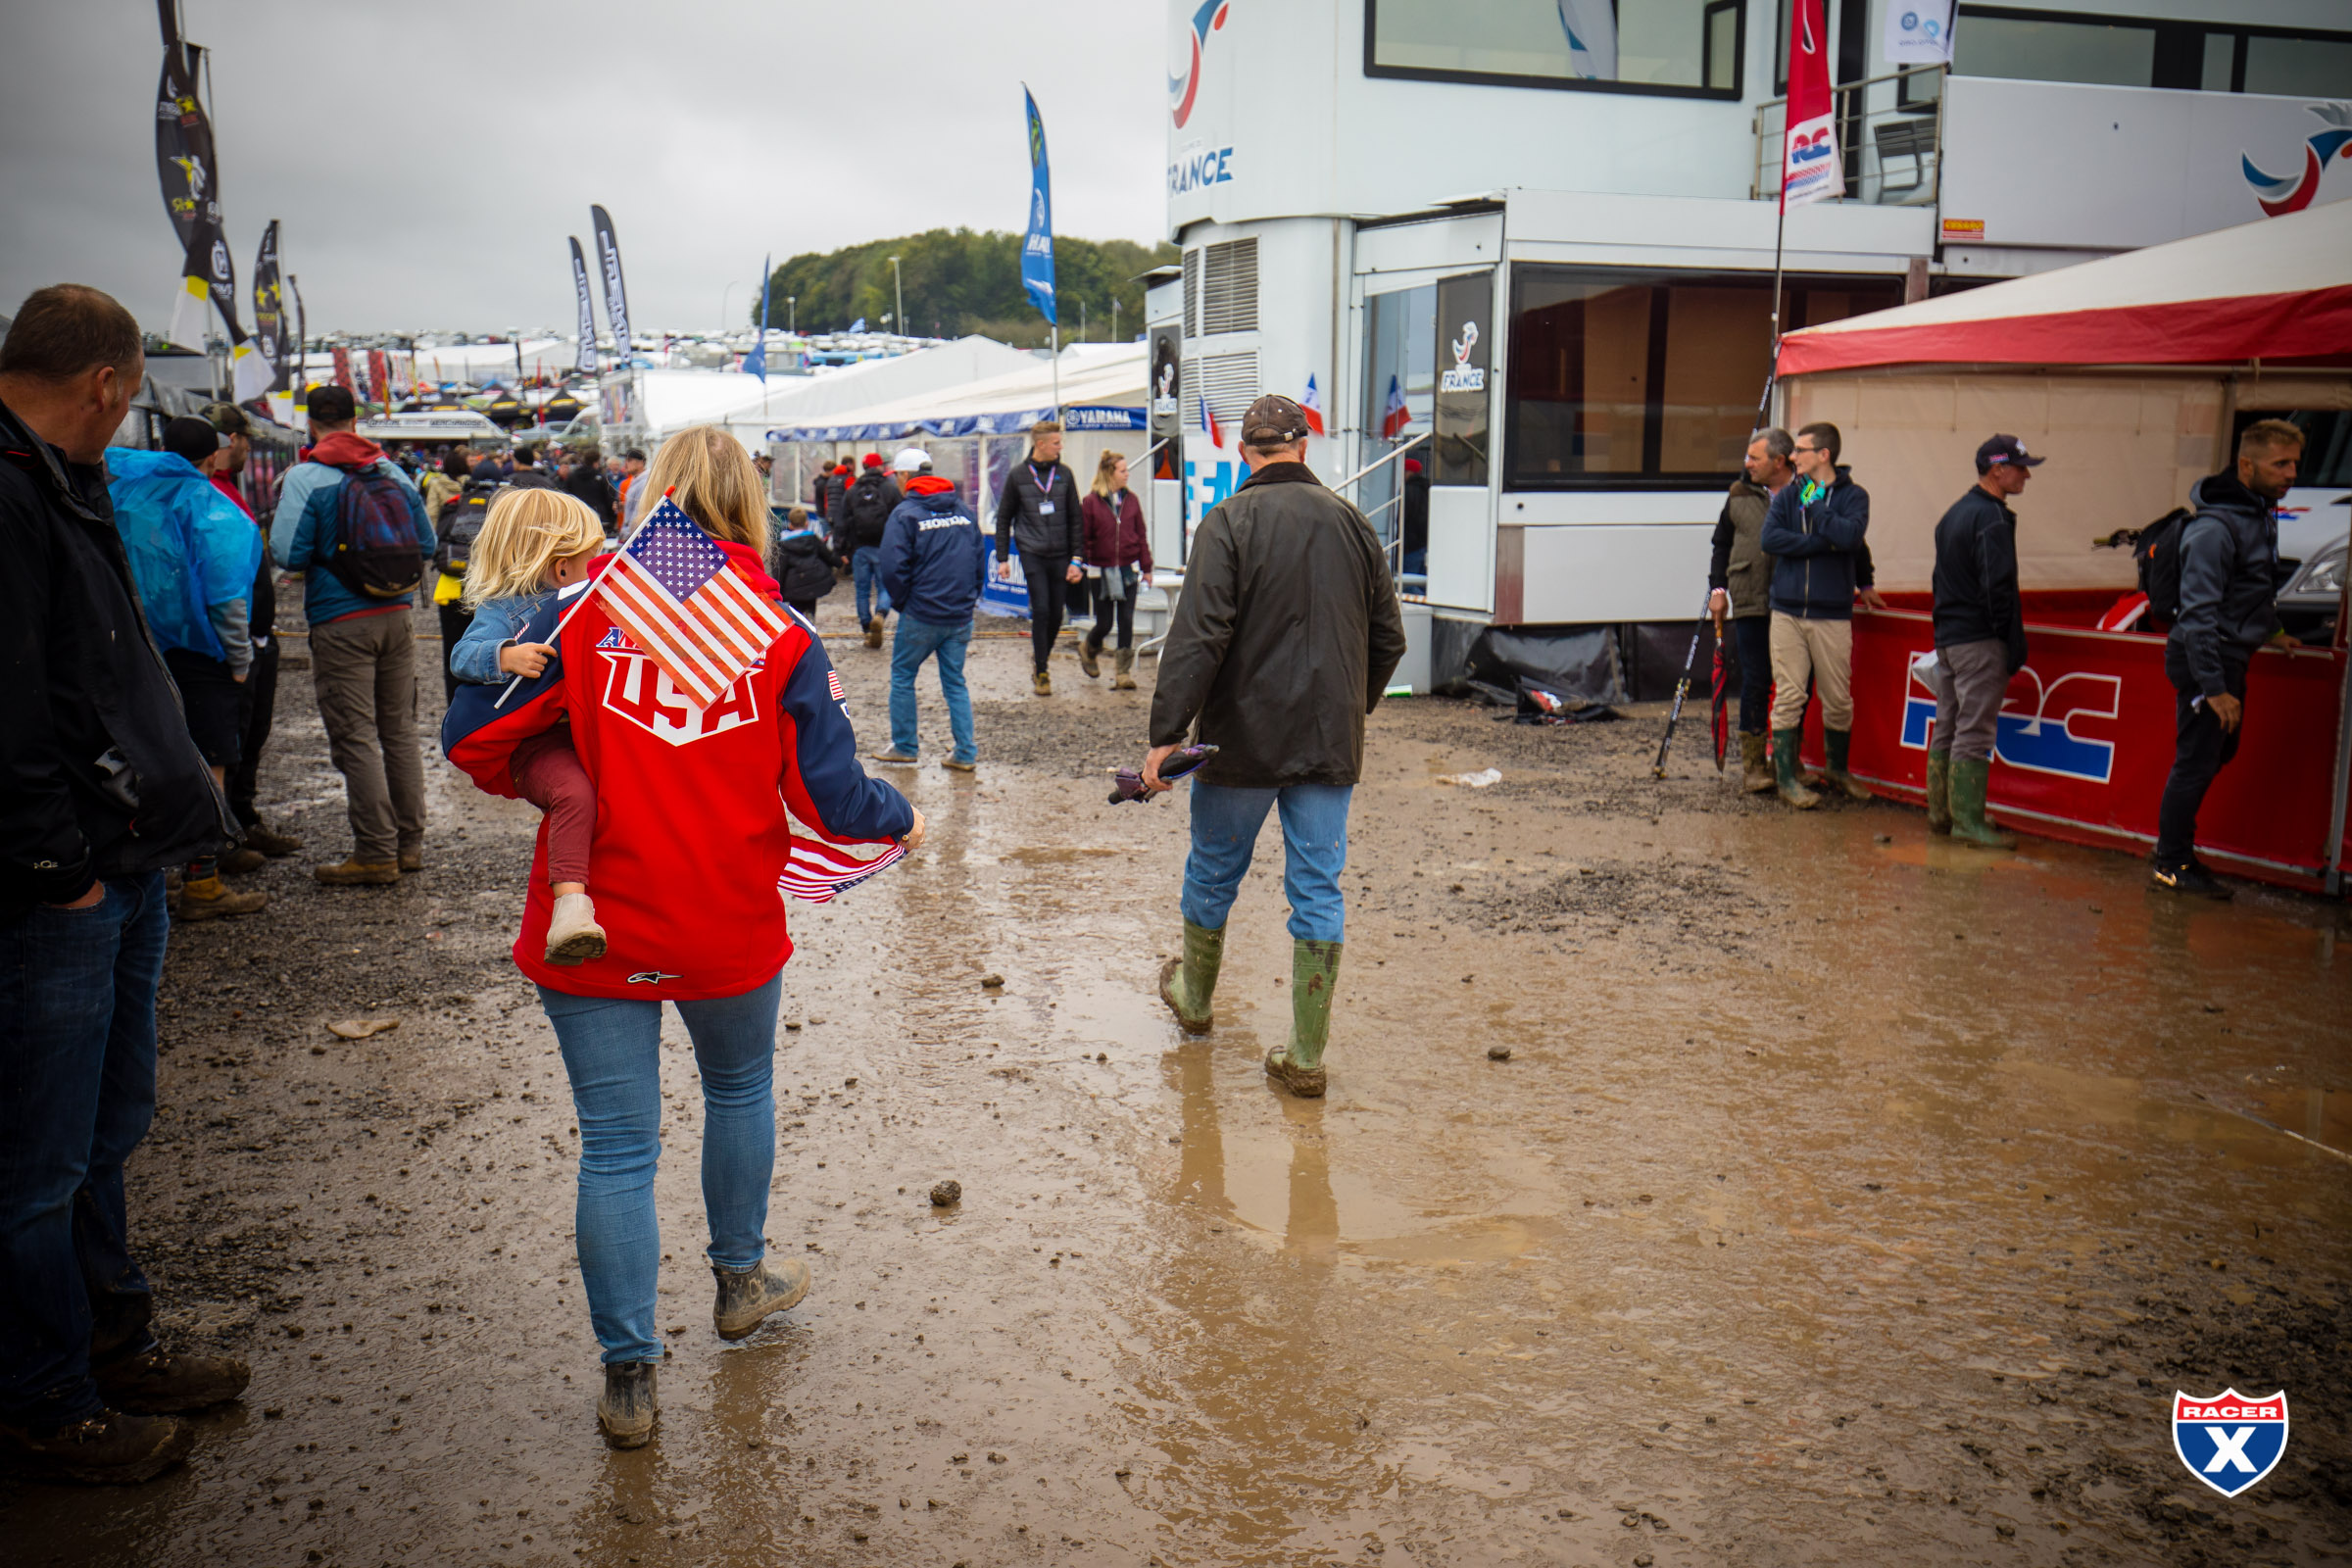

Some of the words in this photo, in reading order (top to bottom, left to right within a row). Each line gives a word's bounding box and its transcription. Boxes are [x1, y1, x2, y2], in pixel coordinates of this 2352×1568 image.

[1443, 371, 1484, 390] FRANCE
[1079, 409, 1132, 424] YAMAHA
[917, 514, 972, 532] HONDA
[607, 654, 757, 736] USA
